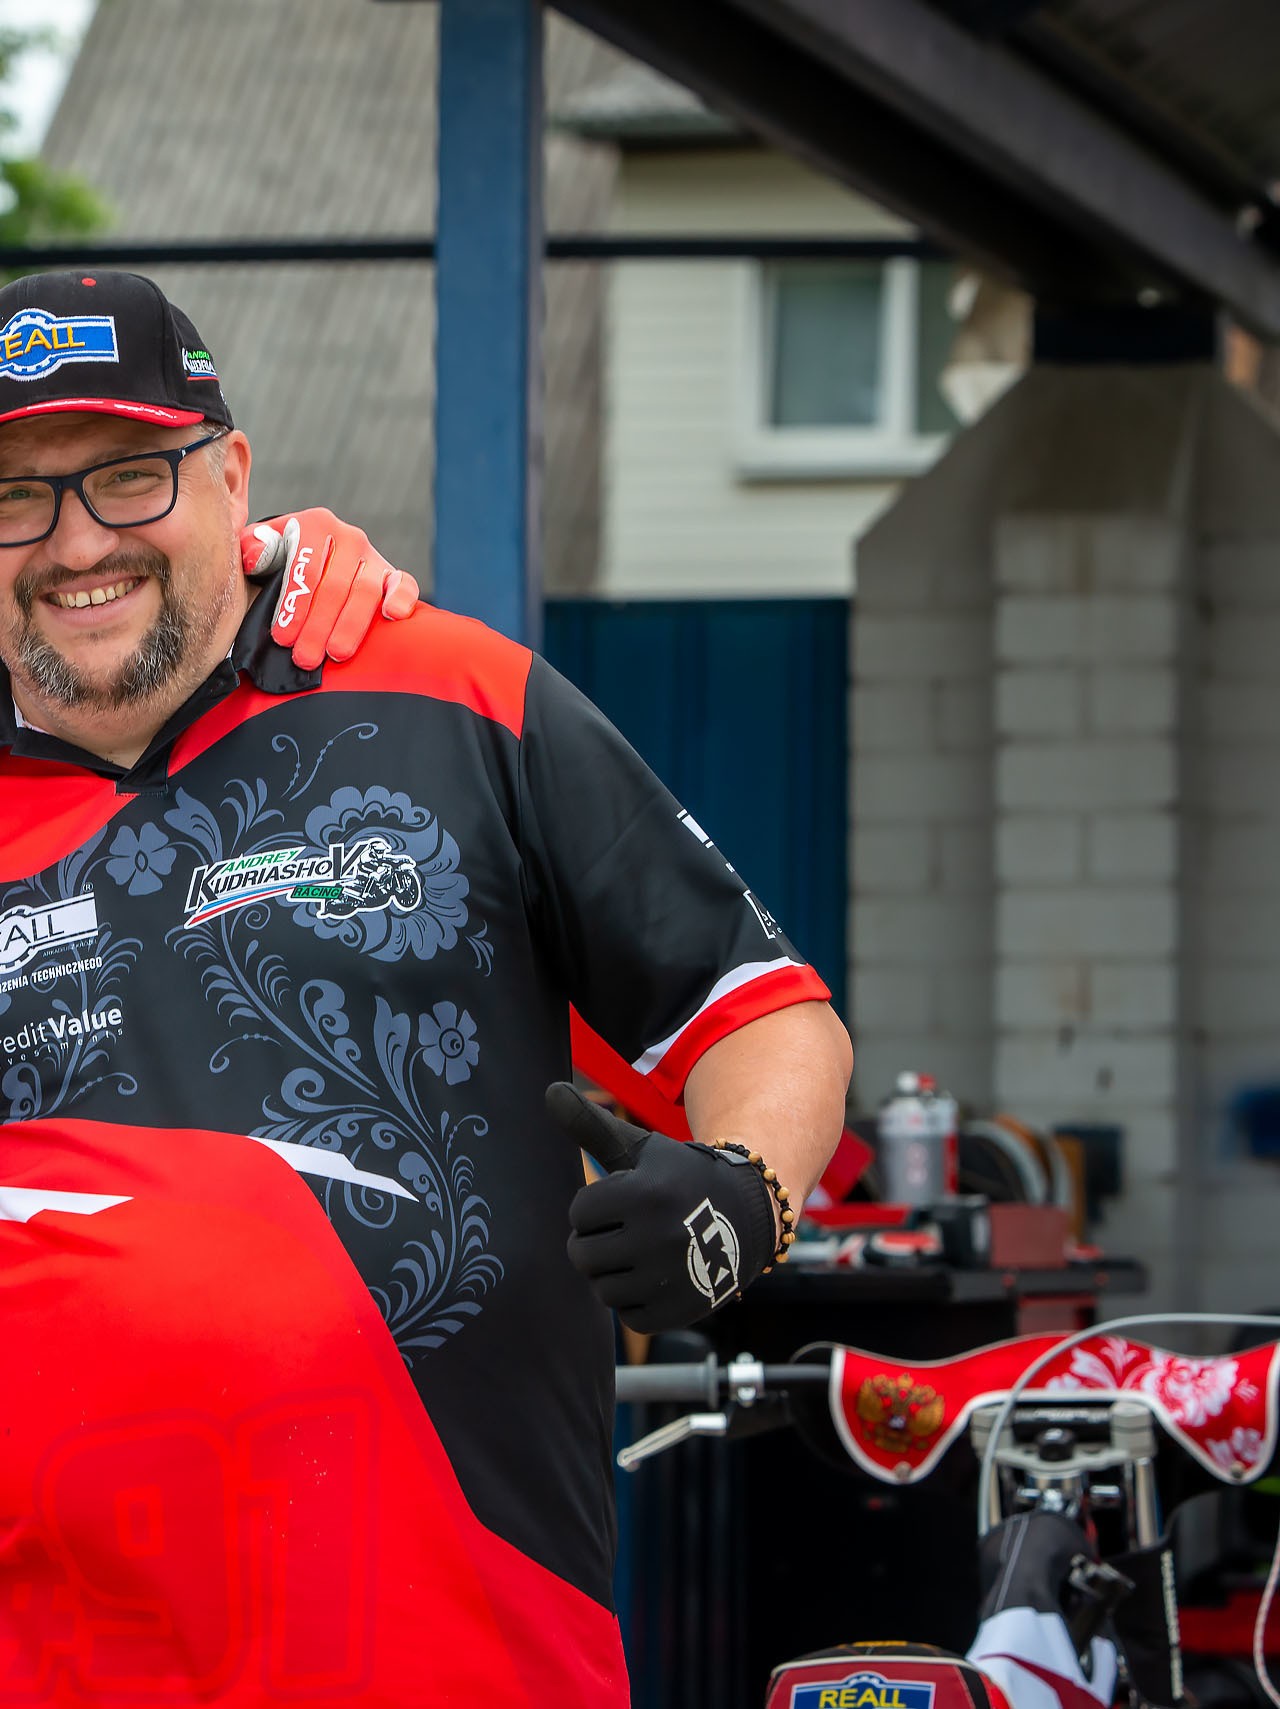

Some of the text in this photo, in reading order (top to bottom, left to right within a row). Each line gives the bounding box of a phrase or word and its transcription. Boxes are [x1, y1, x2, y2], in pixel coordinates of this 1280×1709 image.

[221, 850, 299, 874] ANDREY
[293, 887, 341, 898] RACING
[32, 956, 103, 984] TECHNICZNEGO
[819, 1687, 907, 1708] REALL
